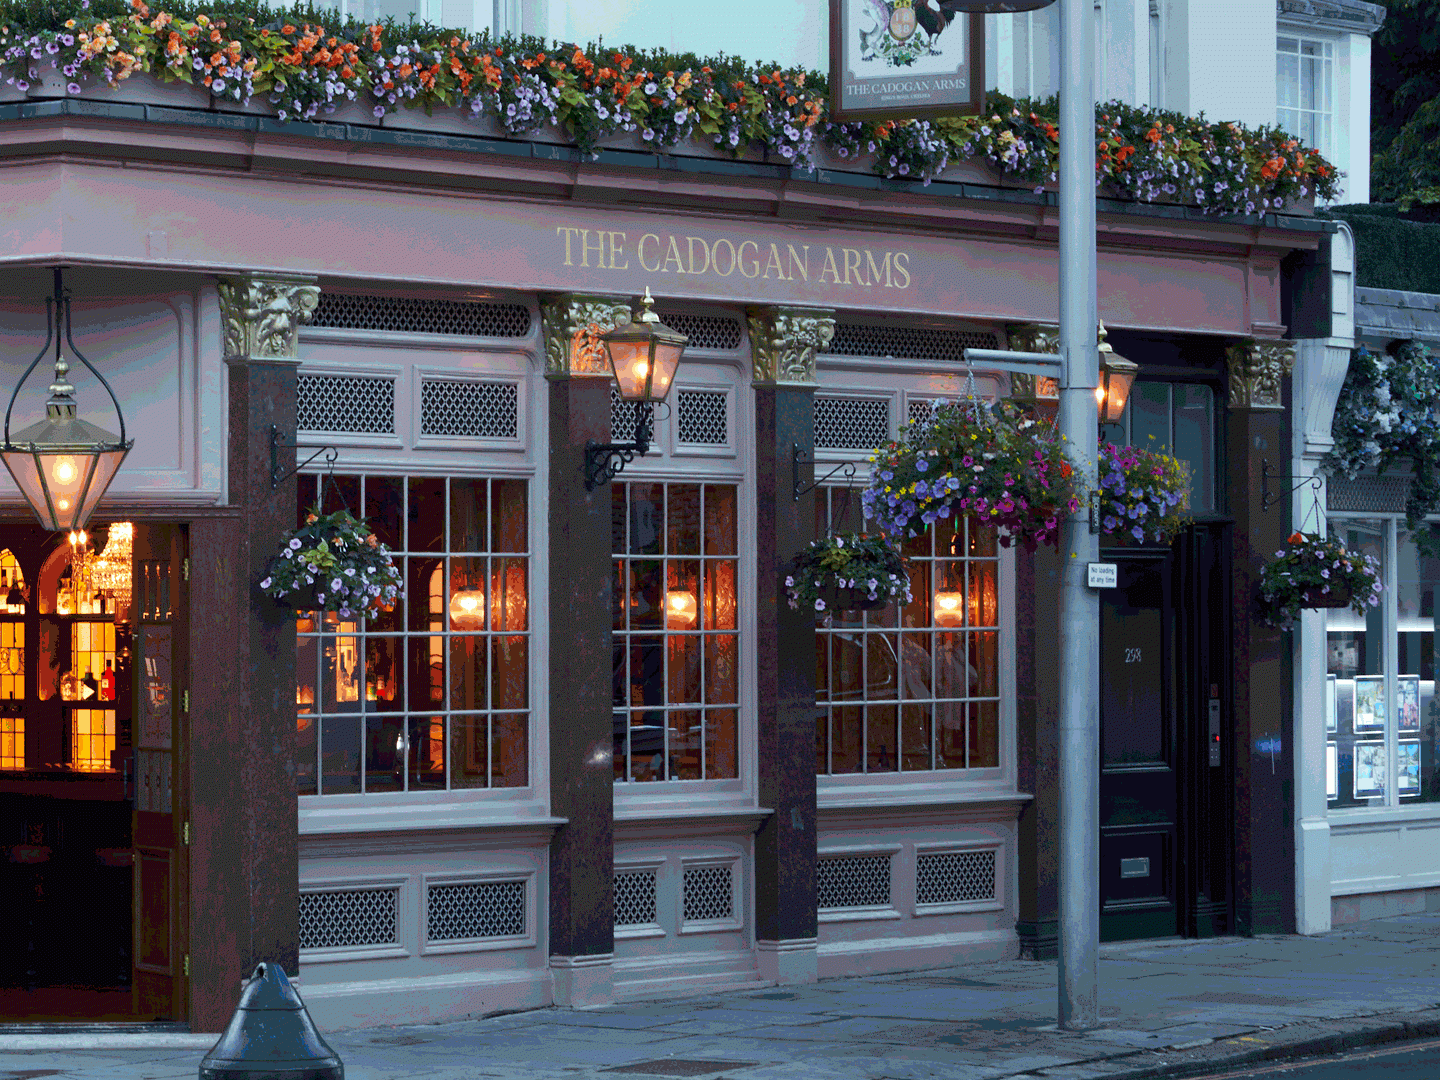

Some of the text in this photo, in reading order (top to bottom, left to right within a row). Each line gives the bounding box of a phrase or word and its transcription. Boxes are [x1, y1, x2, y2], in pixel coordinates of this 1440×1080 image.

[846, 78, 966, 95] THE CADOGAN ARMS
[557, 226, 911, 289] THE CADOGAN ARMS
[1090, 566, 1115, 576] No loading
[1096, 577, 1105, 585] any
[1105, 575, 1115, 584] time
[1124, 647, 1142, 663] 298
